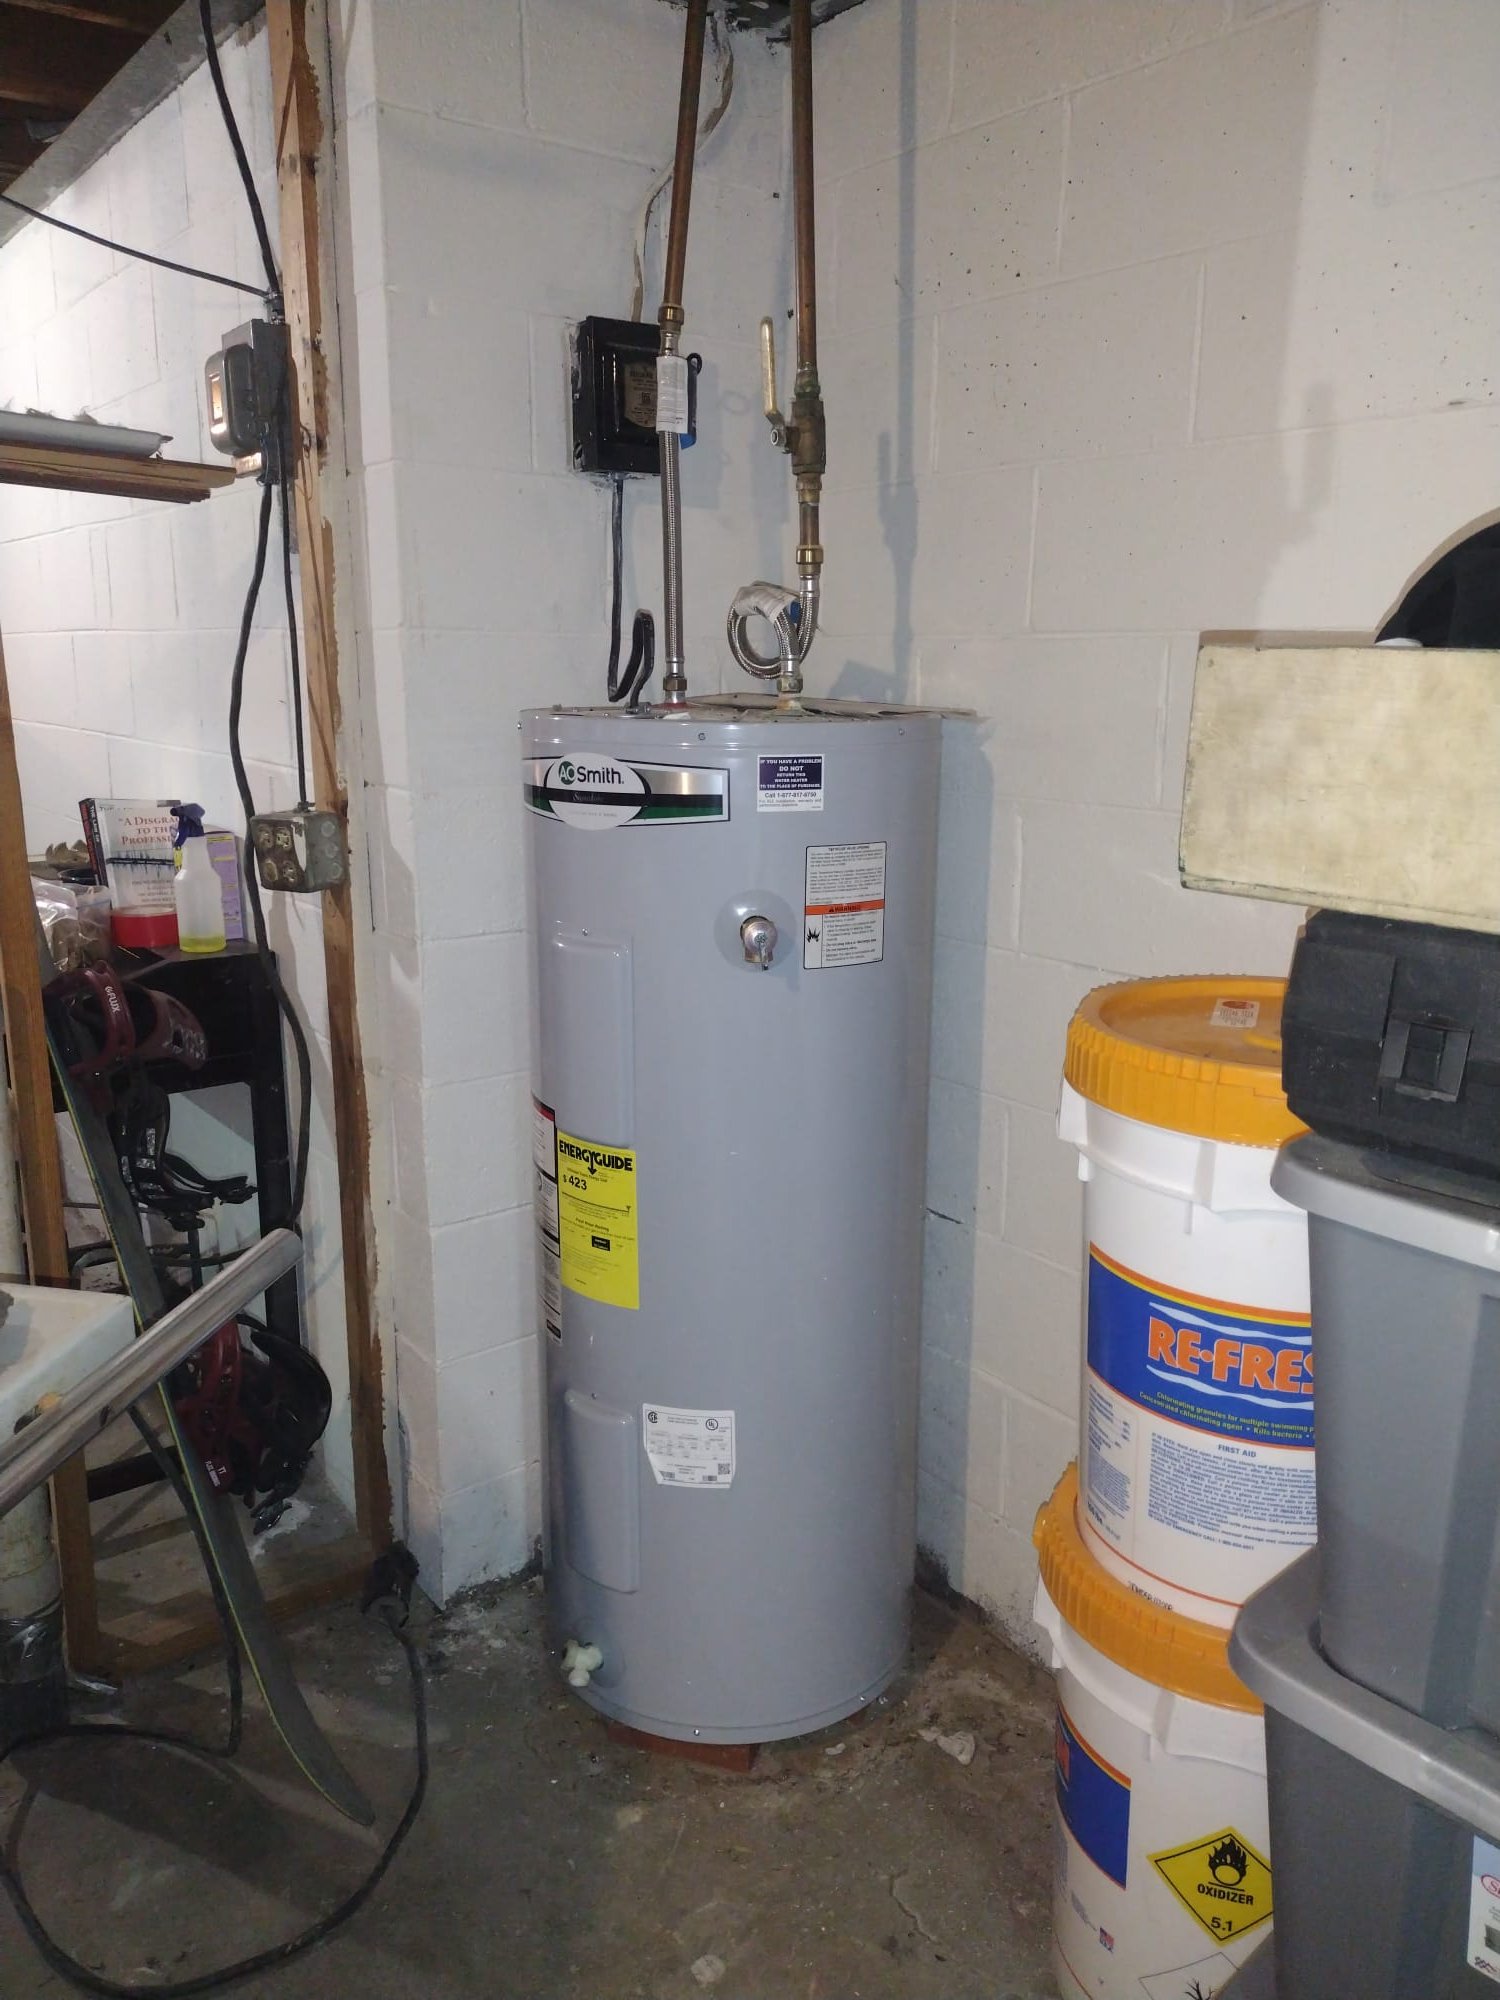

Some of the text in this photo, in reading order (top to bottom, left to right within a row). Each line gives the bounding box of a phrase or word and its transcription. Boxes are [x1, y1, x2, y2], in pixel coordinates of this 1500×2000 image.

[134, 816, 178, 826] DISGRA
[122, 836, 170, 845] PROFESSI
[559, 1140, 633, 1172] ENERGYGUIDE
[1240, 1418, 1269, 1427] multiple
[1223, 1422, 1242, 1431] agent
[1272, 1430, 1302, 1439] bacteria
[1218, 1444, 1256, 1458] FIRST AID
[1197, 1884, 1253, 1905] OXIDIZER
[1211, 1916, 1233, 1932] 5.1
